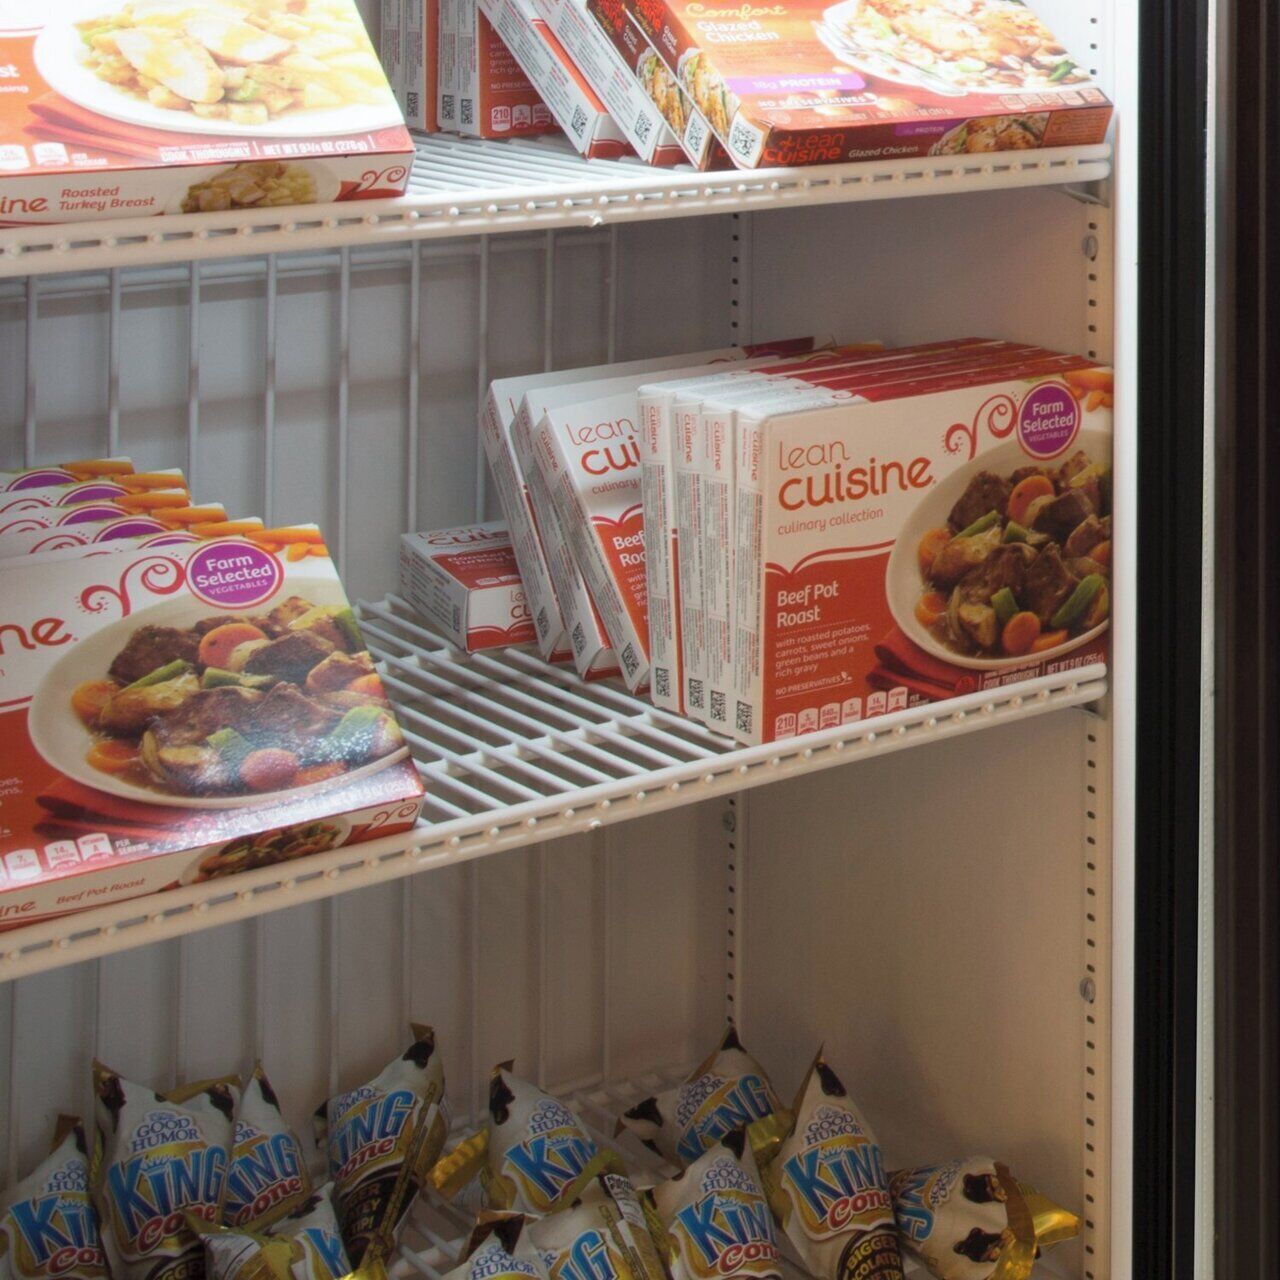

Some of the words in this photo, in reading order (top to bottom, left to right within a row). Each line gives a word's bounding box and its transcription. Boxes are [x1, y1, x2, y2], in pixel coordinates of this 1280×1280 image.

[686, 3, 788, 20] Comfort
[697, 21, 762, 33] Glazed
[706, 29, 780, 44] Chicken
[780, 76, 843, 89] PROTEIN
[160, 149, 188, 163] COOK
[190, 146, 251, 162] THOROUGHLY
[849, 148, 881, 158] Glazed
[884, 145, 919, 157] Chicken
[61, 186, 119, 199] Roasted
[60, 197, 107, 212] Turkey
[110, 195, 155, 209] Breast
[1032, 401, 1064, 416] Farm
[567, 418, 639, 446] lean
[1023, 412, 1074, 433] Selected
[1029, 430, 1068, 442] VEGETABLES
[779, 440, 850, 471] lean
[592, 479, 638, 495] culinary
[779, 456, 934, 511] cuisine
[778, 519, 826, 536] culinary
[828, 507, 884, 528] collection
[206, 554, 254, 571] Farm
[197, 564, 273, 588] Selected
[208, 579, 268, 596] VEGETABLES
[777, 585, 811, 607] Beef
[814, 580, 839, 600] Pot
[777, 605, 821, 628] Roast
[776, 637, 796, 649] with
[797, 630, 831, 644] roasted
[811, 639, 836, 652] sweet
[776, 656, 801, 671] green
[803, 650, 829, 663] beans
[830, 646, 848, 658] and
[776, 667, 793, 679] rich
[794, 662, 819, 678] gravy
[788, 674, 842, 694] PRESERVATIVES
[57, 890, 85, 905] Beef
[86, 885, 109, 899] Pot
[110, 877, 147, 893] Roast
[137, 1118, 192, 1139] GOOD
[808, 1112, 854, 1135] GOOD
[131, 1128, 200, 1153] HUMOR
[806, 1124, 863, 1147] HUMOR
[706, 1167, 750, 1184] GOOD
[106, 1145, 230, 1245] KING
[702, 1178, 760, 1194] HUMOR
[826, 1187, 892, 1231] Cone
